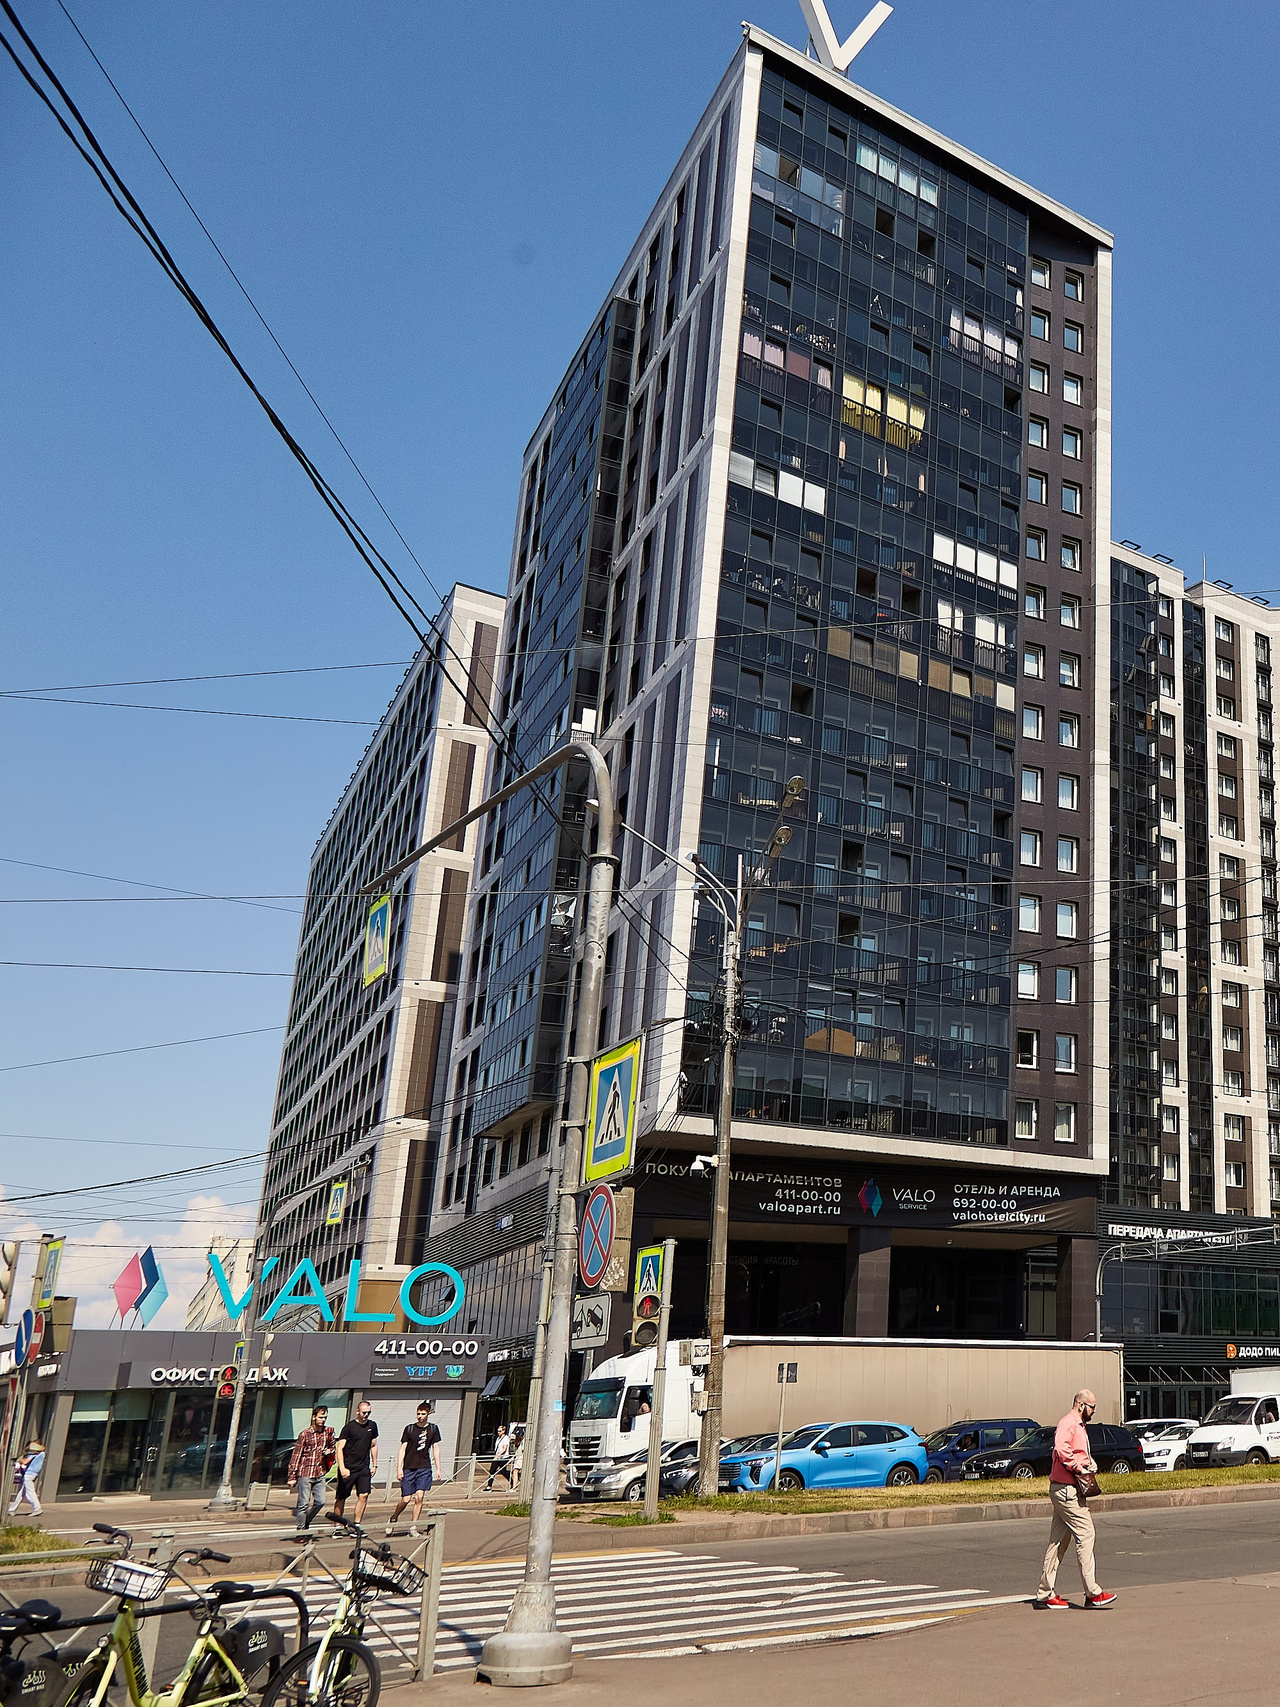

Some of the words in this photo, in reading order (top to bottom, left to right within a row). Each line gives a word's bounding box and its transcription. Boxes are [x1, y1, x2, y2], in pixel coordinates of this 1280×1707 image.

[799, 0, 894, 72] V
[645, 1162, 713, 1179] ПОКУК
[775, 1188, 841, 1203] 411-00-00
[892, 1187, 936, 1203] VALO
[953, 1184, 996, 1196] ОТЕЛЬ
[998, 1185, 1008, 1196] И
[1010, 1185, 1061, 1199] АРЕНДА
[759, 1200, 841, 1216] valoapart.ru
[898, 1203, 928, 1211] SERVICE
[952, 1198, 1017, 1210] 692-00-00
[952, 1210, 1046, 1225] valohotelcity.ru
[1107, 1223, 1165, 1240] ПЕРЕДАЧА
[208, 1253, 466, 1327] VALO
[374, 1339, 479, 1356] 411-00-00
[1238, 1346, 1264, 1358] ДОДО
[150, 1366, 207, 1383] ОФИС
[404, 1365, 438, 1377] YIT
